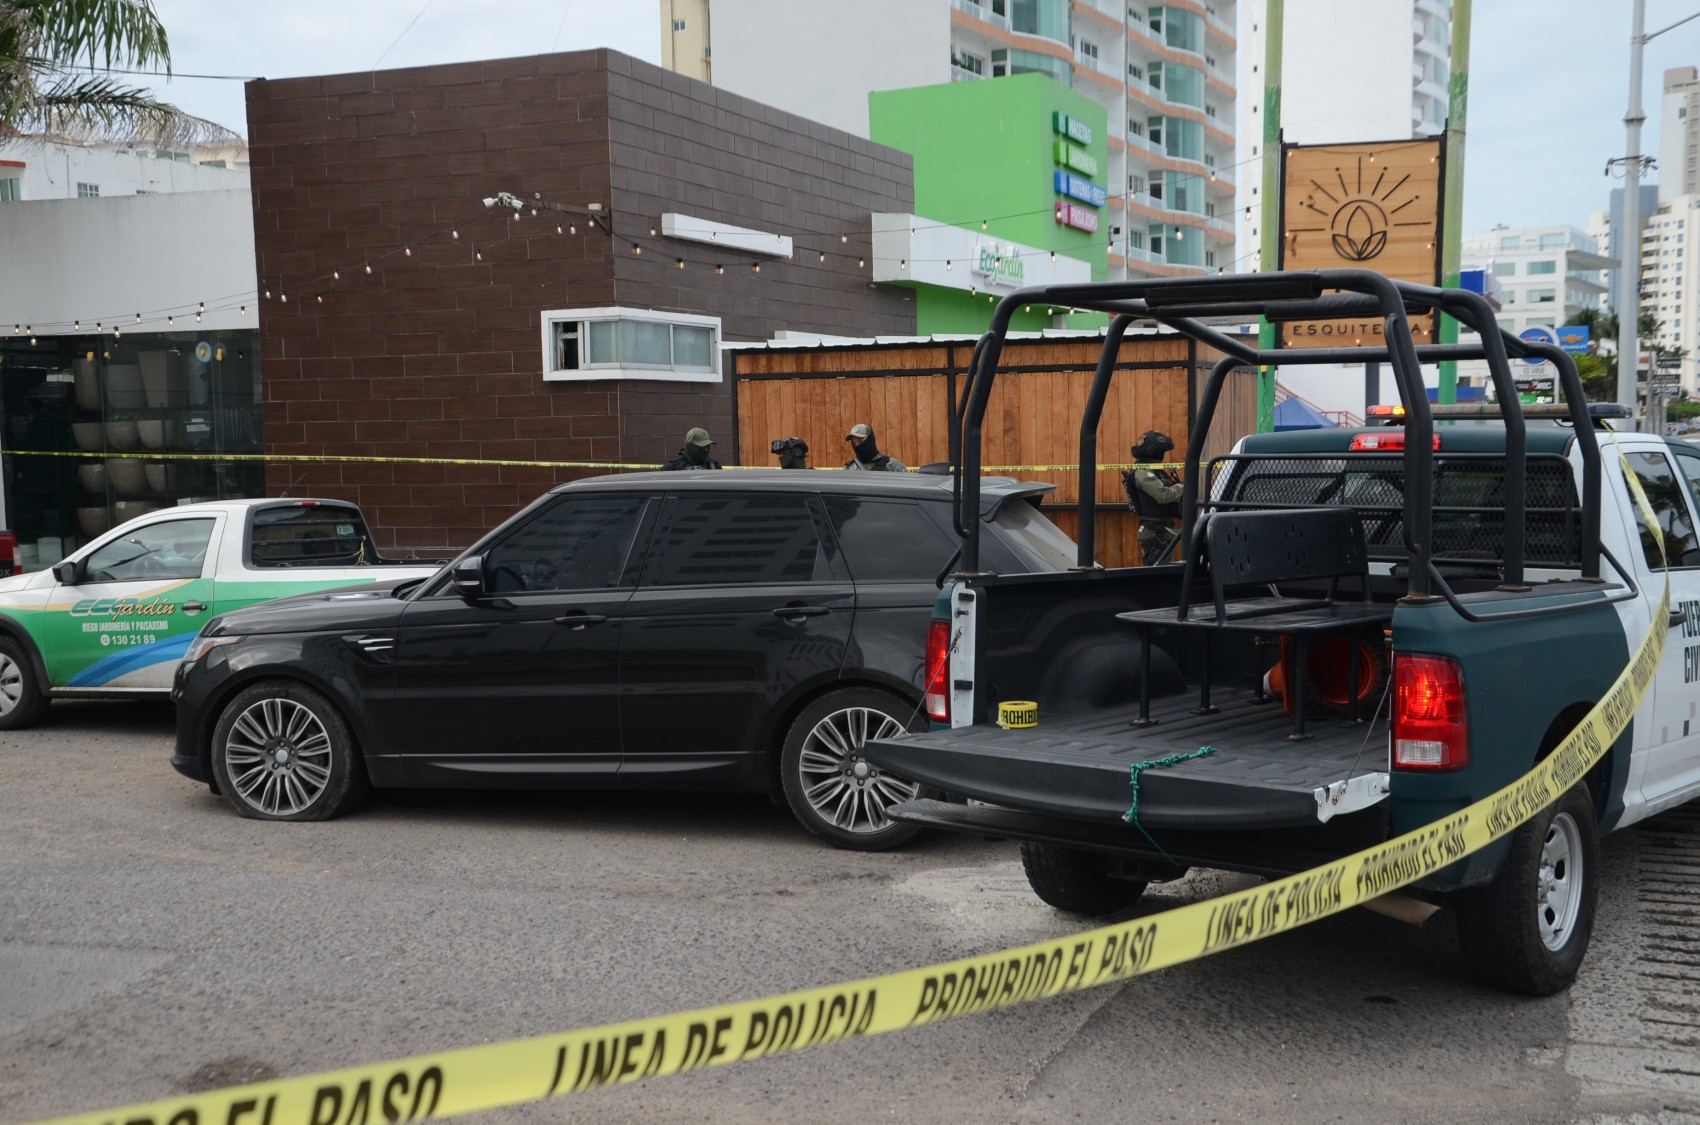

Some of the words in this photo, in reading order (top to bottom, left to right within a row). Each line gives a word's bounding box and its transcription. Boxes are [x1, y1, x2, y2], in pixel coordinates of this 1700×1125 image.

[1292, 323, 1422, 336] ESQUITEA
[82, 622, 98, 633] RIEGO
[130, 621, 135, 631] Y
[136, 620, 168, 631] PAISAJISMO
[111, 635, 128, 645] 130
[130, 635, 141, 645] 21
[143, 634, 156, 644] 89
[549, 1029, 667, 1093] LINEA
[677, 1017, 733, 1072] DE
[740, 989, 877, 1058] POLICIA
[909, 947, 1063, 1026] PROHIBIDO
[1063, 940, 1093, 990] EL
[1095, 922, 1158, 980] PASO
[1202, 895, 1259, 953] LINEA
[1259, 885, 1287, 937] DE
[1283, 865, 1346, 930] POLICIA
